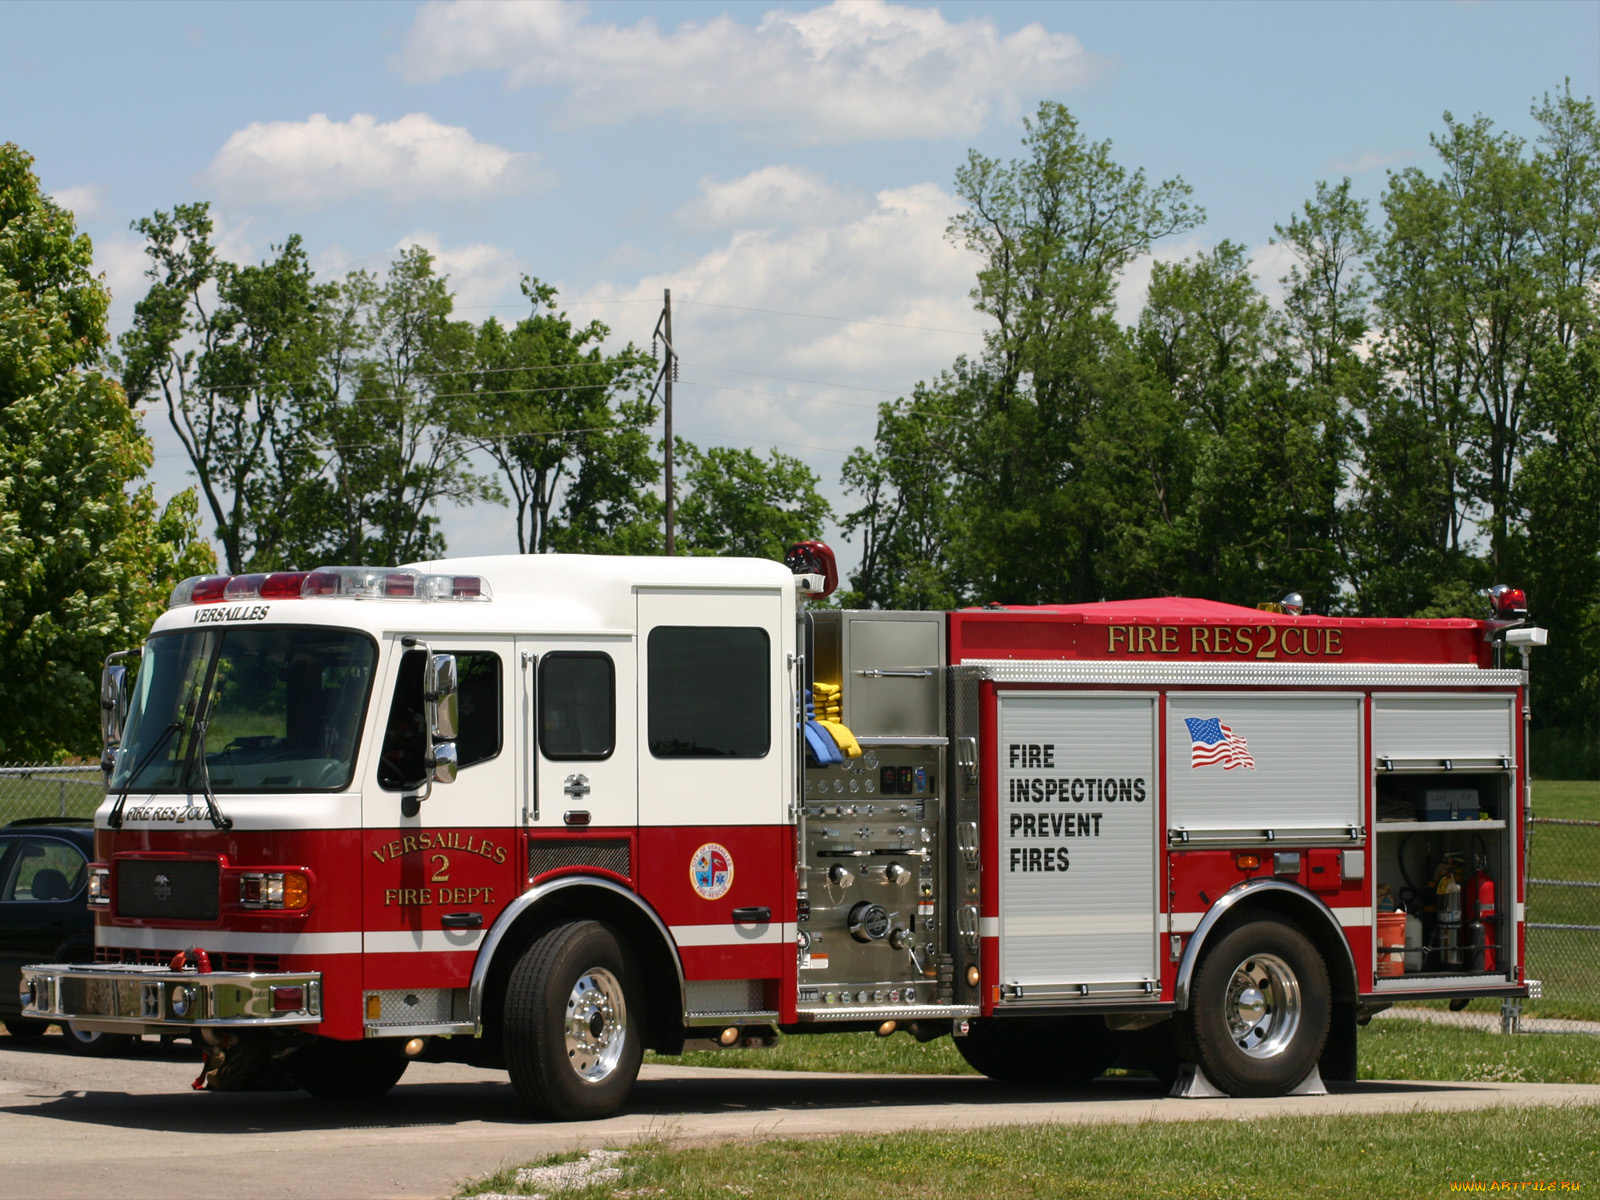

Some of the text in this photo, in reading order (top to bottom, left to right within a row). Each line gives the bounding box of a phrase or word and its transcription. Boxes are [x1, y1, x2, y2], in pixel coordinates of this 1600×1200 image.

[194, 606, 271, 623] VERSAILLES
[1107, 625, 1343, 659] FIRE RES2CUE
[1009, 744, 1055, 768] FIRE
[1009, 778, 1146, 803] INSPECTIONS
[126, 806, 153, 821] FIRE
[1009, 812, 1103, 837] PREVENT
[372, 832, 507, 864] VERSAILLES
[1009, 847, 1070, 872] FIRES
[430, 854, 450, 882] 2
[384, 887, 495, 906] FIRE DEPT.
